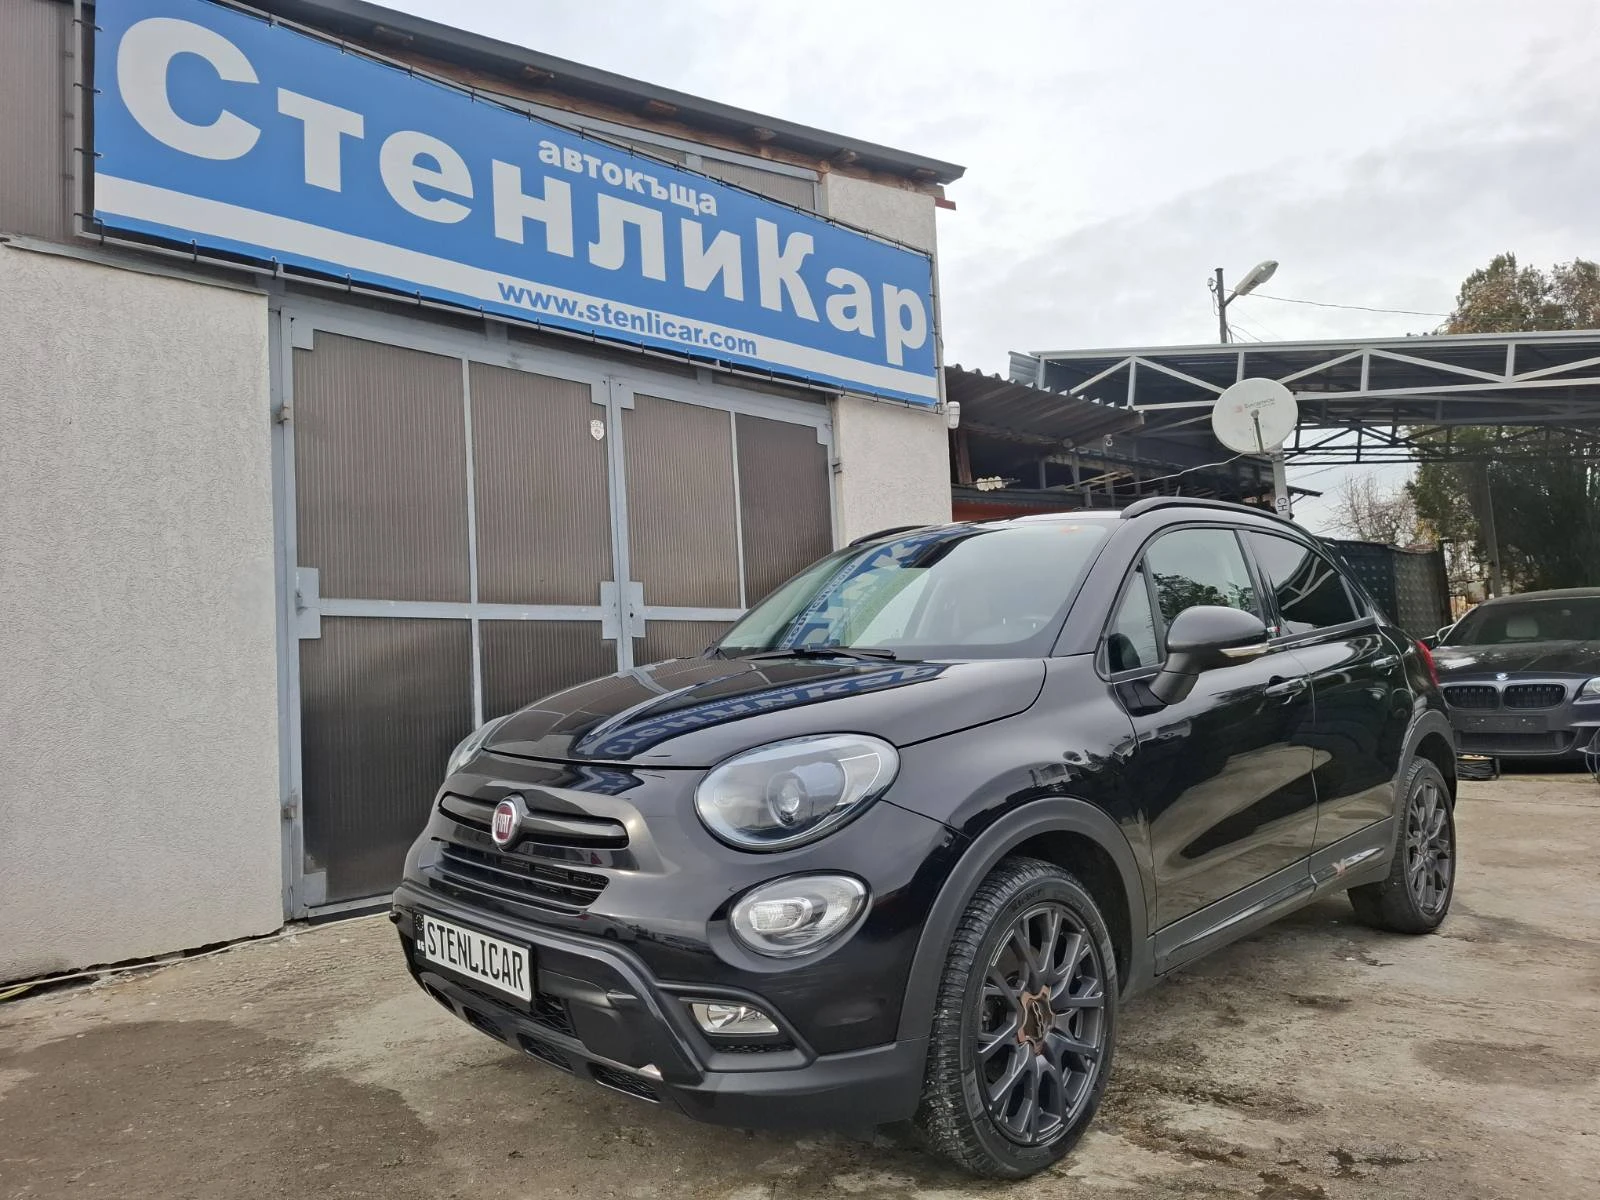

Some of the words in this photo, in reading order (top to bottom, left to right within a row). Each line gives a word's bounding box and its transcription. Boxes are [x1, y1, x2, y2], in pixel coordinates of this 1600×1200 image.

[117, 17, 928, 366] СтенлиКар
[538, 140, 718, 216] автокъща
[498, 282, 757, 356] www.stenlicar.com
[496, 813, 512, 834] FIAT
[427, 921, 524, 992] STENLICAR
